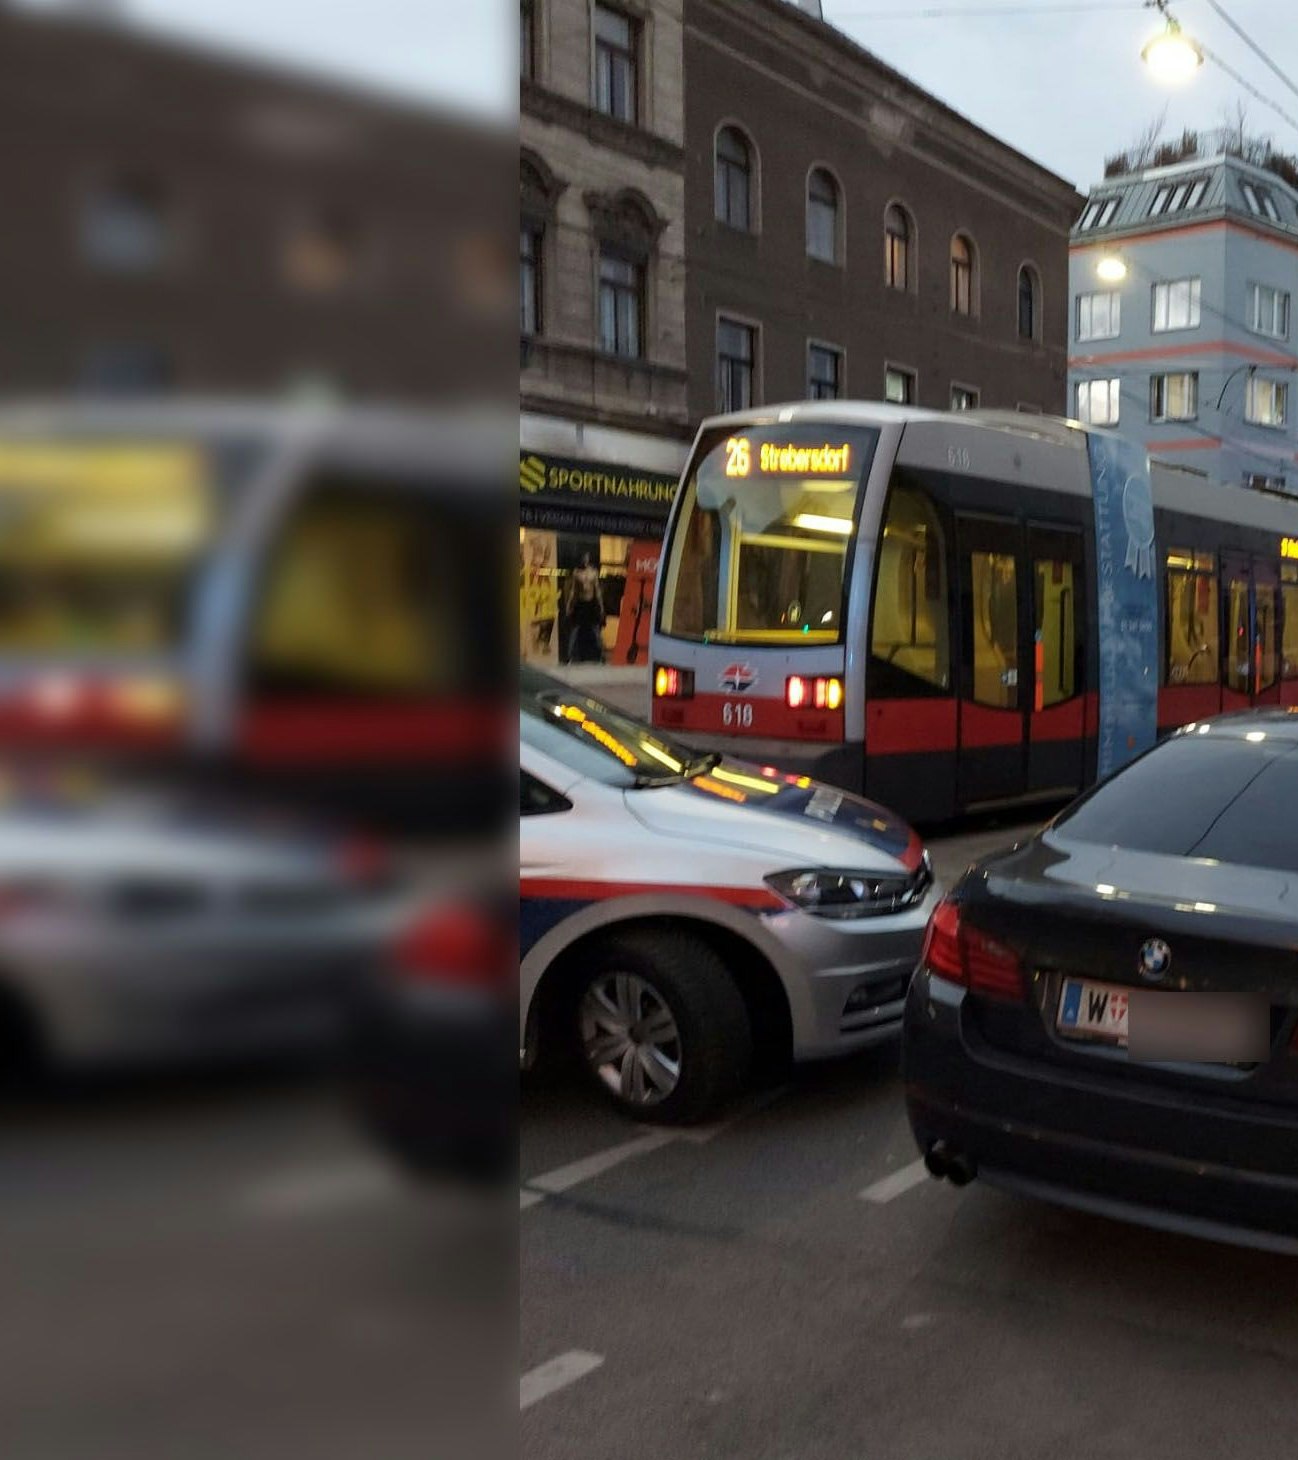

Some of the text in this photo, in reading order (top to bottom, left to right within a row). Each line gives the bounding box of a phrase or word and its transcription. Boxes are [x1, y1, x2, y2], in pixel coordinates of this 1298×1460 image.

[726, 437, 750, 477] 26
[723, 702, 753, 727] 618
[1088, 990, 1109, 1023] W
